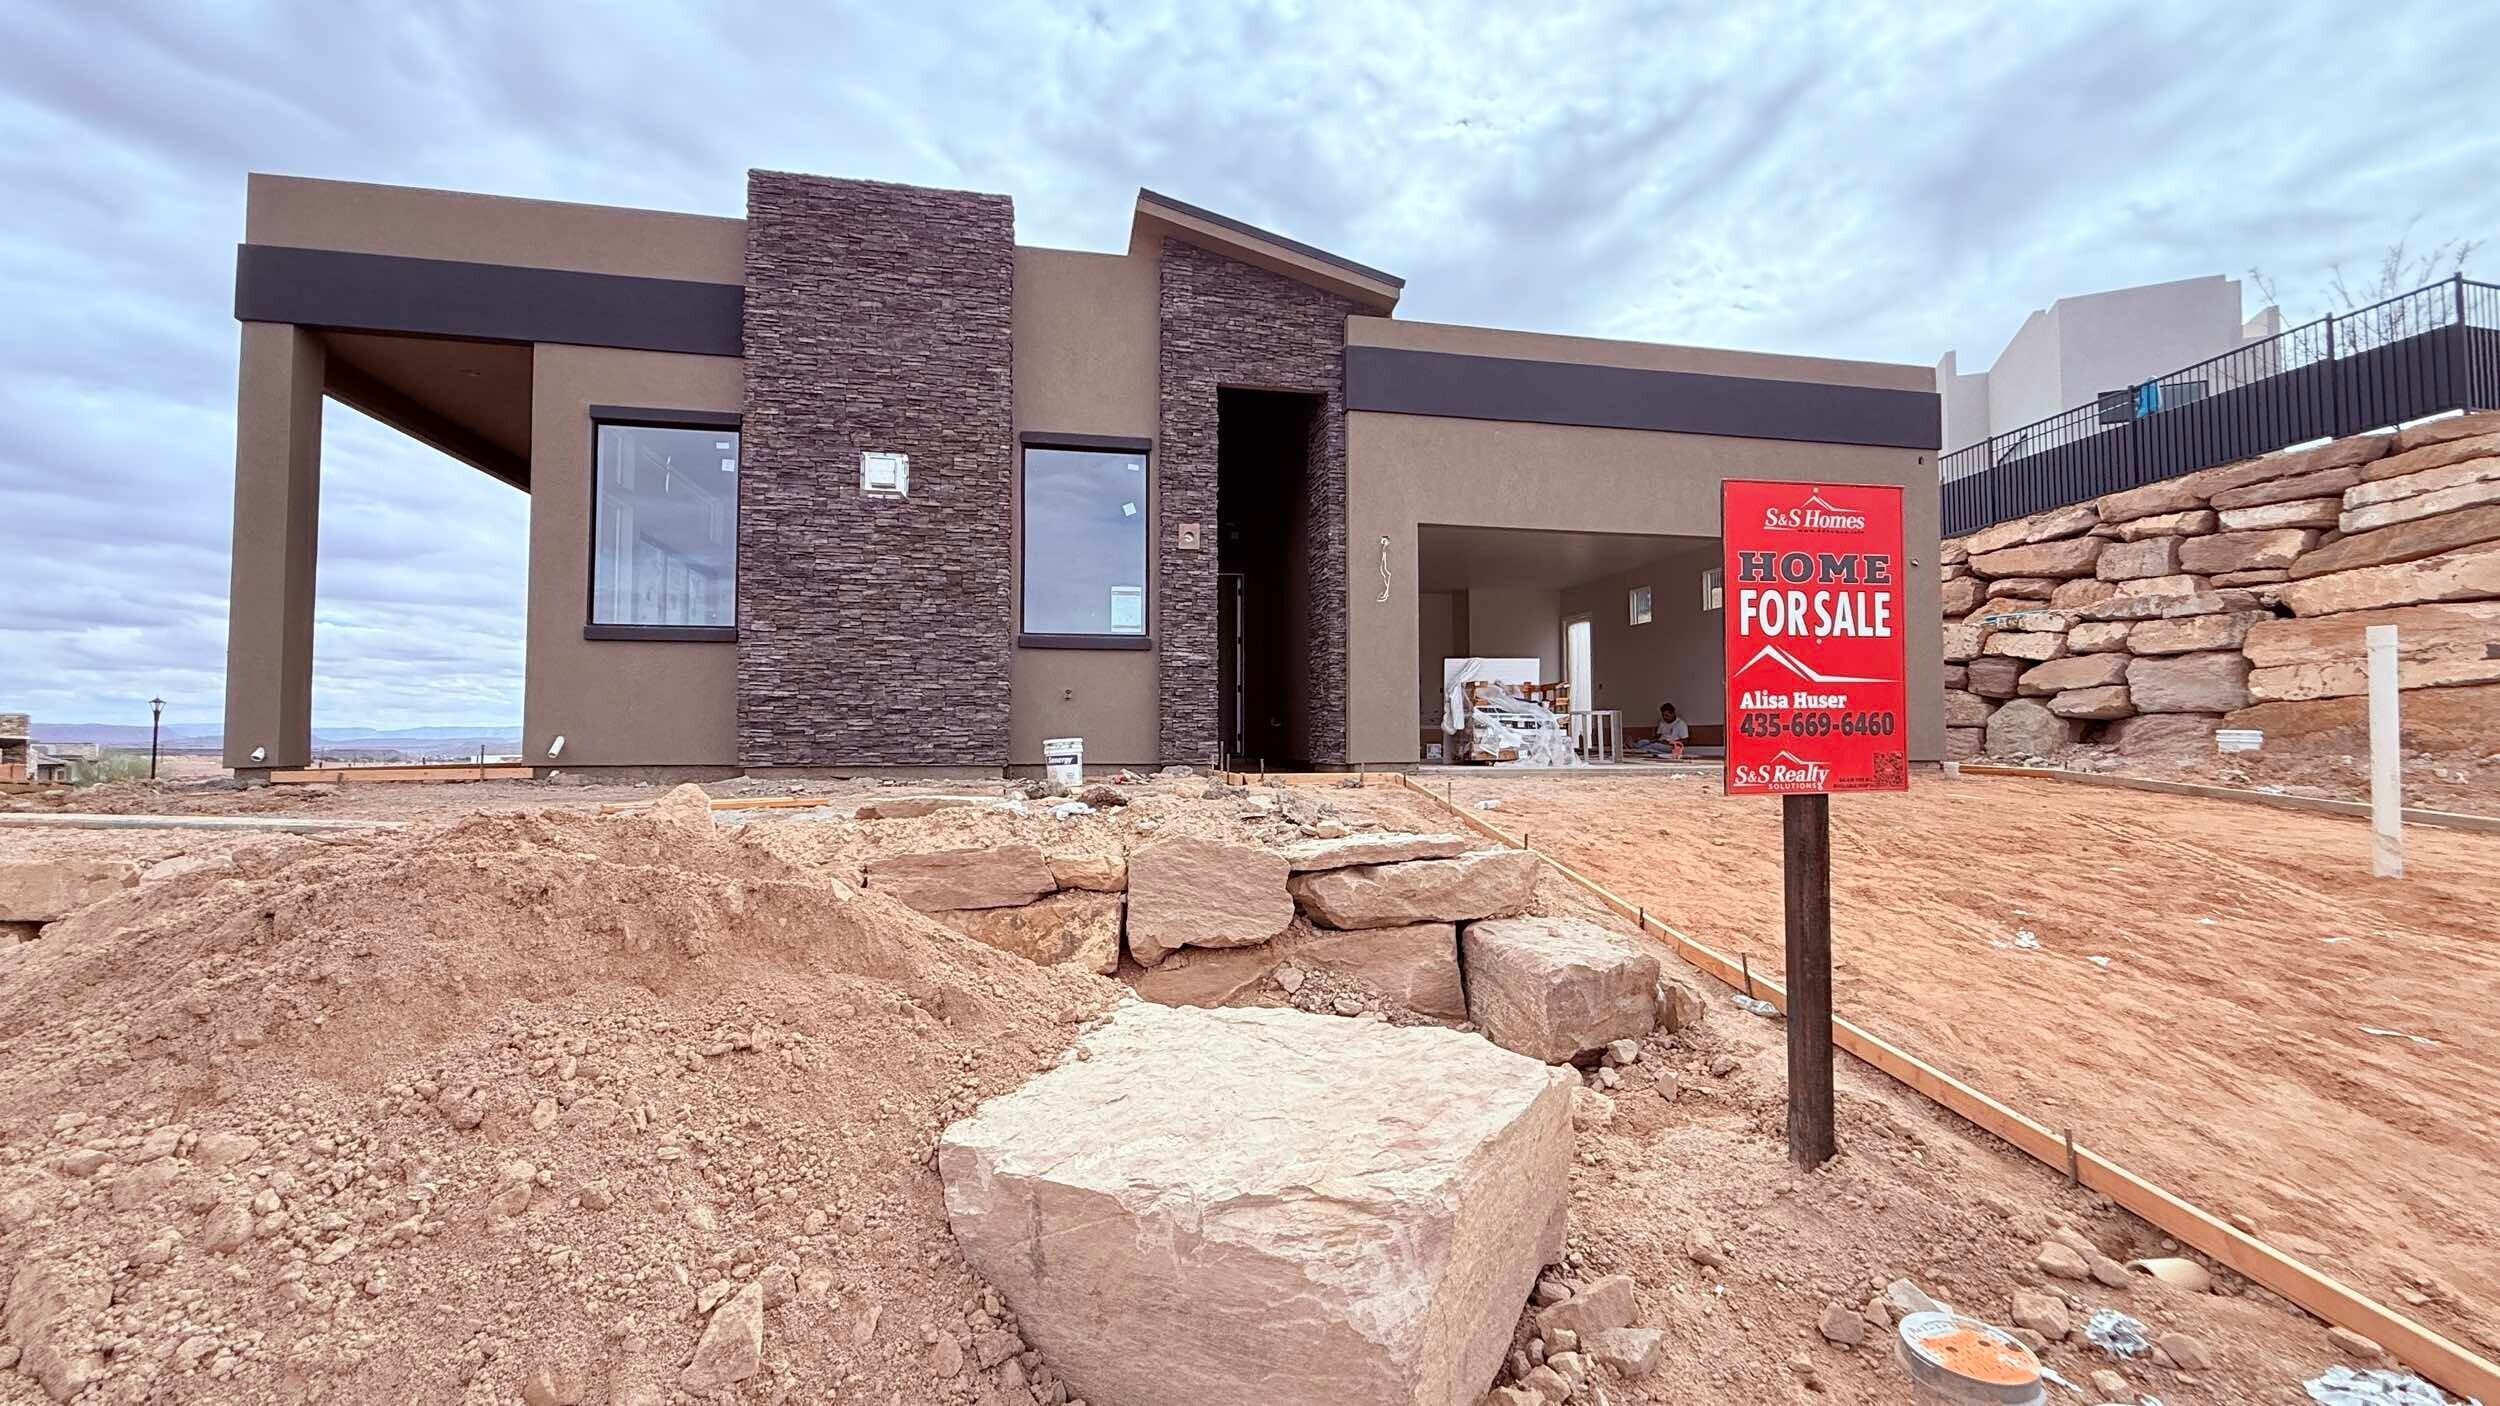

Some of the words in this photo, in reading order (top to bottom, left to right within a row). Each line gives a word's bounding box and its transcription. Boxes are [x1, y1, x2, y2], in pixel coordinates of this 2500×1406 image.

[1765, 508, 1801, 527] S&S
[1804, 510, 1865, 529] Homes
[1738, 551, 1892, 585] HOME
[1740, 589, 1808, 636] FOR
[1814, 590, 1891, 637] SALE
[1740, 691, 1789, 709] Alisa
[1793, 692, 1847, 709] Huser
[1740, 712, 1894, 737] 435-669-6460
[1735, 765, 1769, 783] S&S
[1773, 763, 1829, 786] Realty
[1768, 782, 1817, 790] SOLUTIONS
